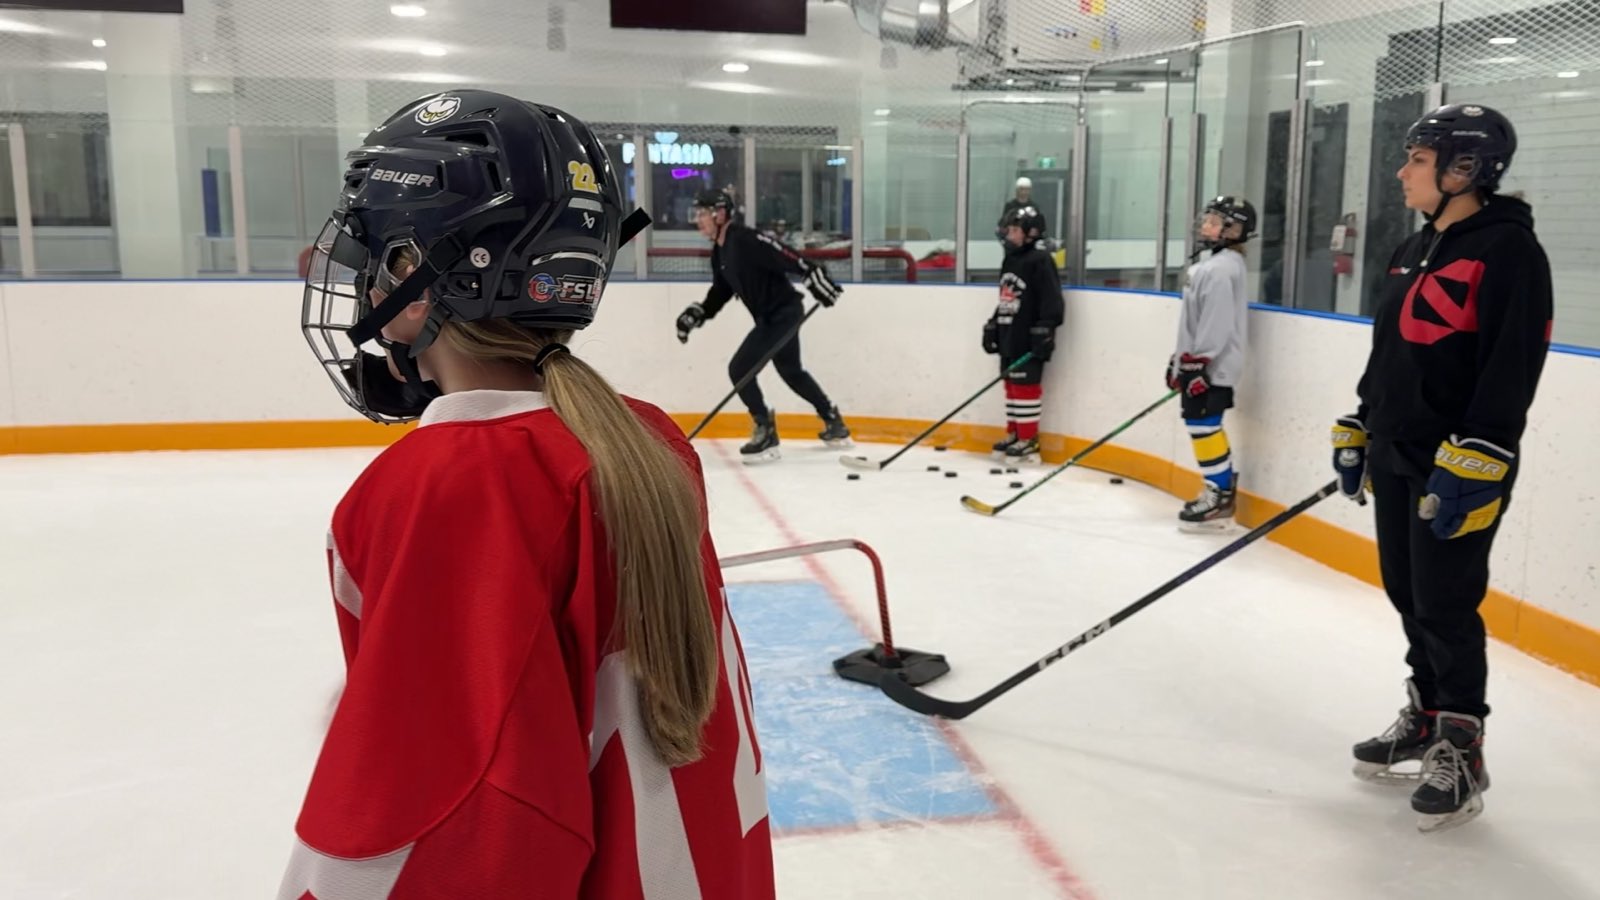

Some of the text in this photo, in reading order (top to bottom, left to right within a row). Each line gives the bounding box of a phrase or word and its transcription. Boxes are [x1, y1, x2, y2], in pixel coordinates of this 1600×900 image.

[622, 142, 714, 165] FNTASIA
[370, 168, 435, 187] BAUER
[567, 160, 600, 194] 22
[1435, 446, 1501, 477] AUER
[1038, 617, 1111, 672] CCM
